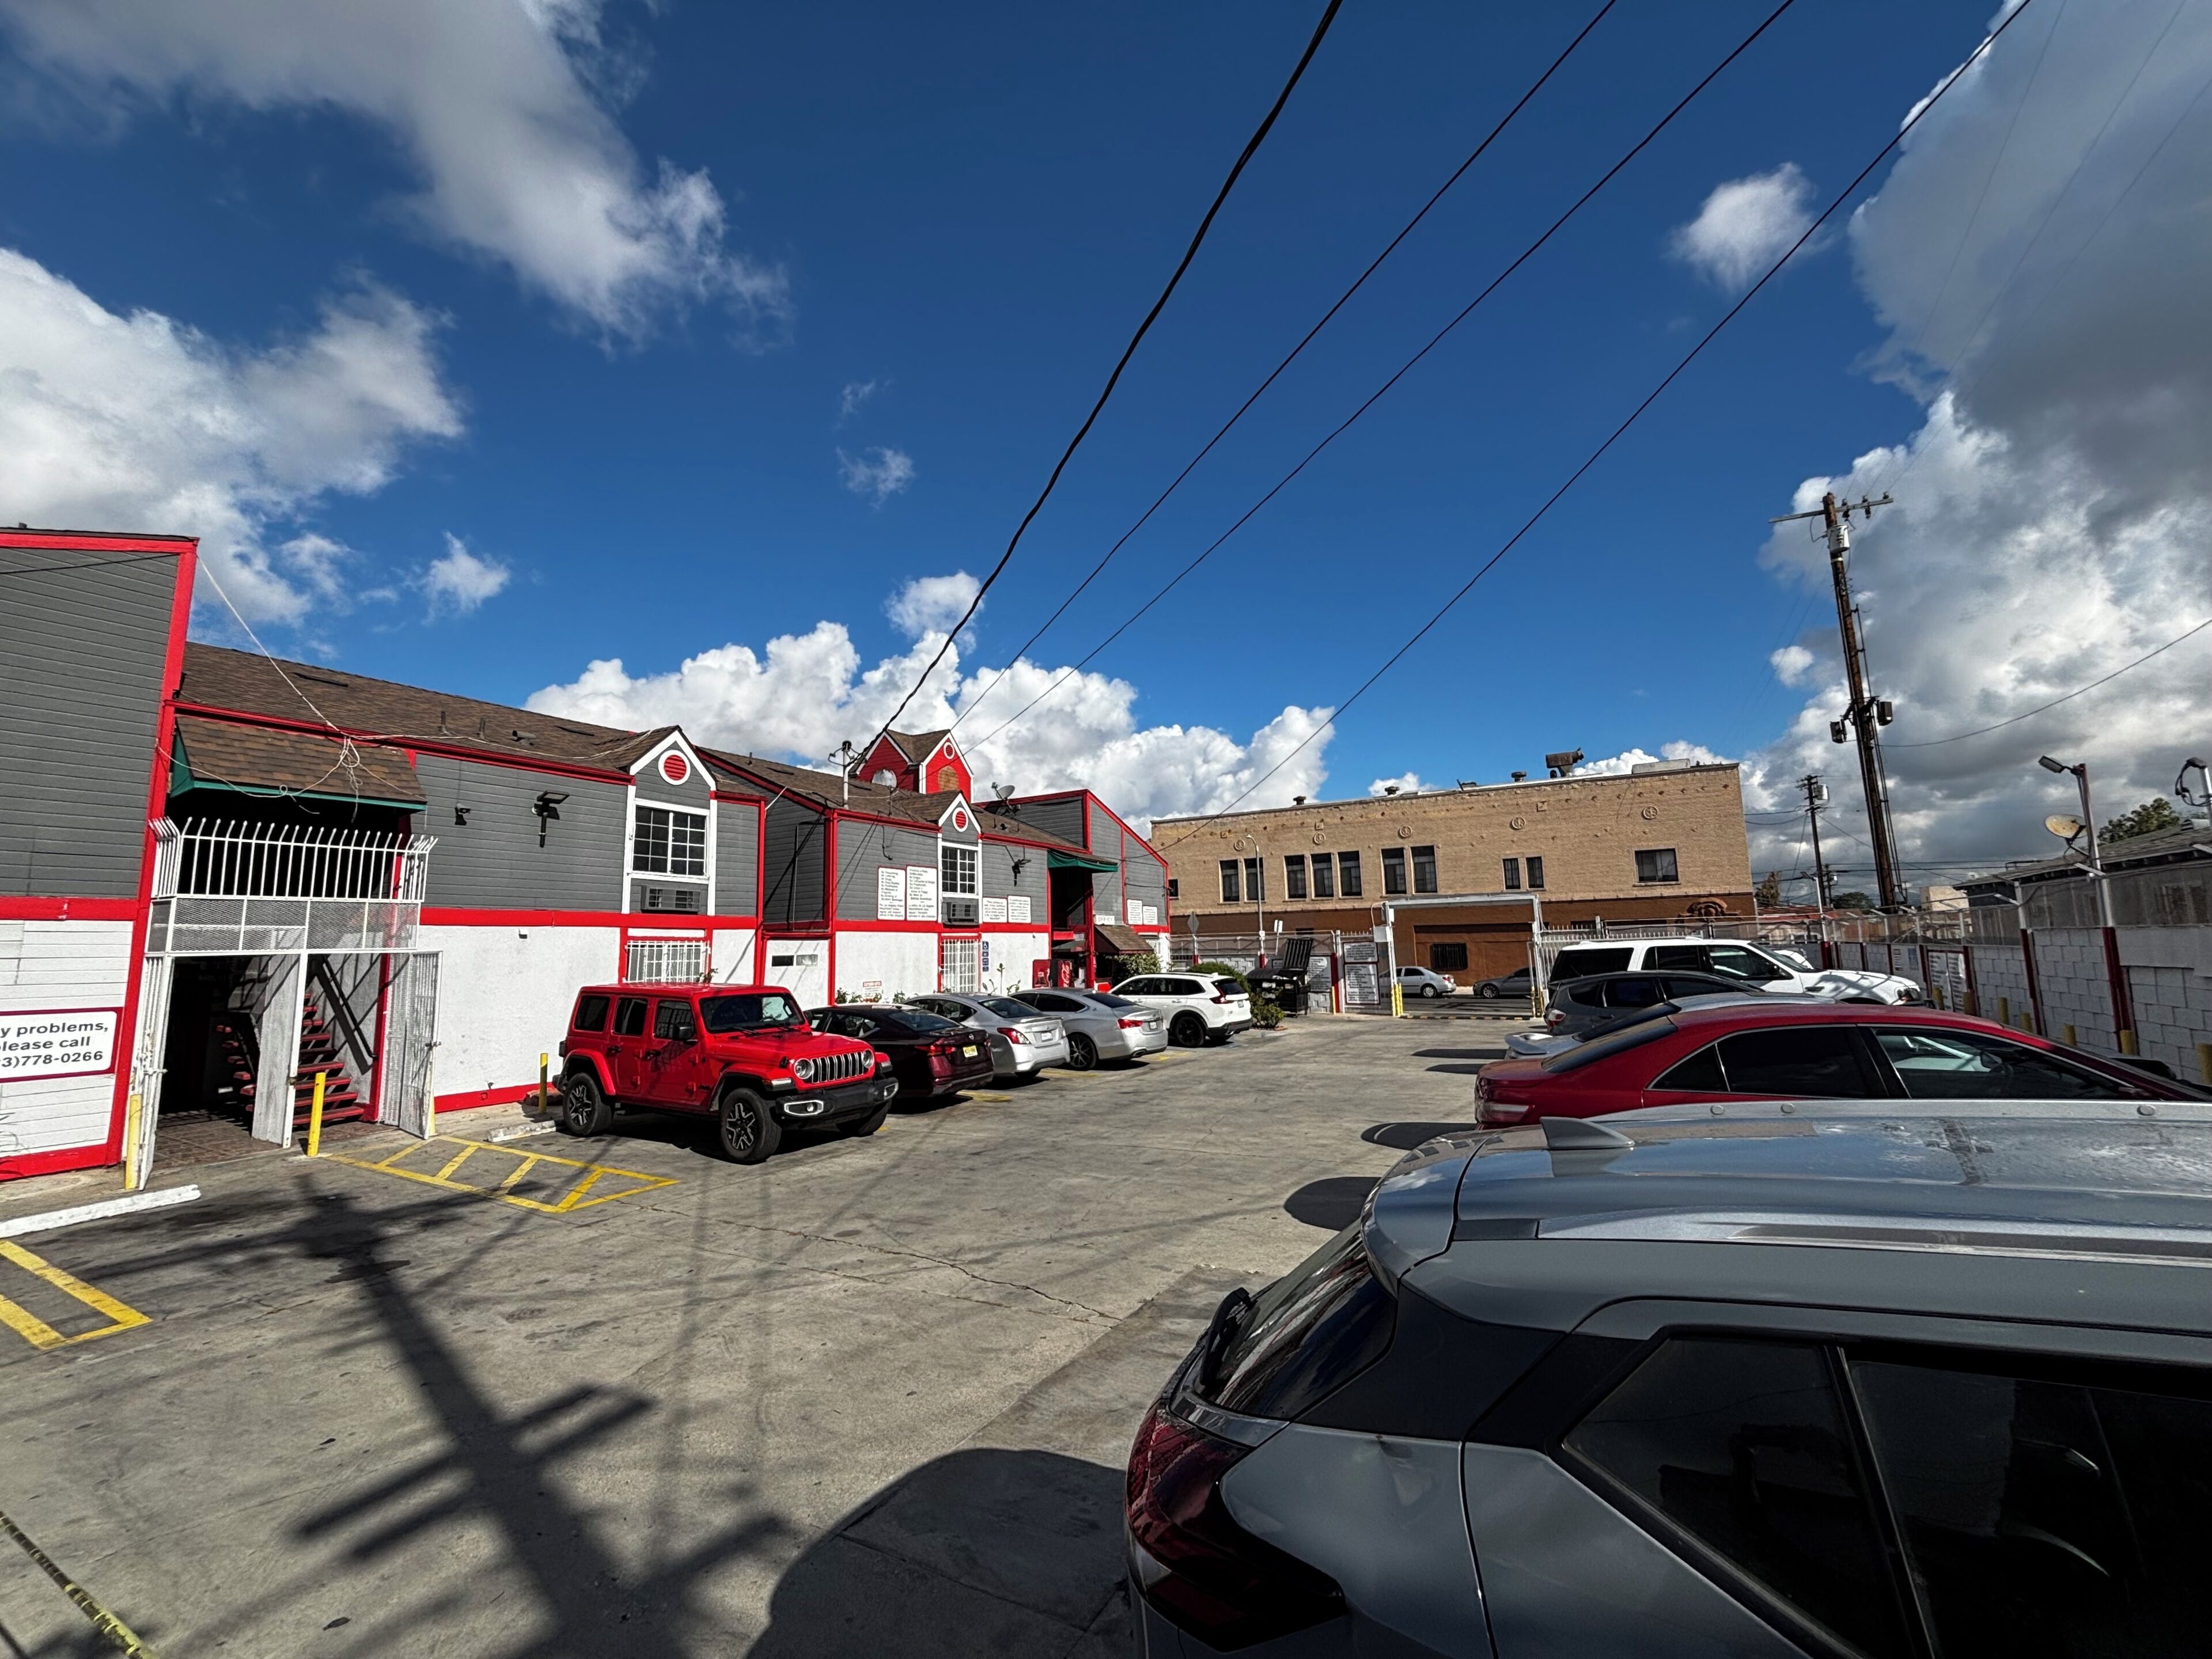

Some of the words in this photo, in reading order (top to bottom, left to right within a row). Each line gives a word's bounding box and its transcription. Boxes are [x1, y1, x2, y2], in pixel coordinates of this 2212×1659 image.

[16, 1022, 108, 1037] problems,
[0, 1040, 54, 1052] lease
[59, 1036, 91, 1048] call
[0, 1051, 103, 1069] 3)778-0266
